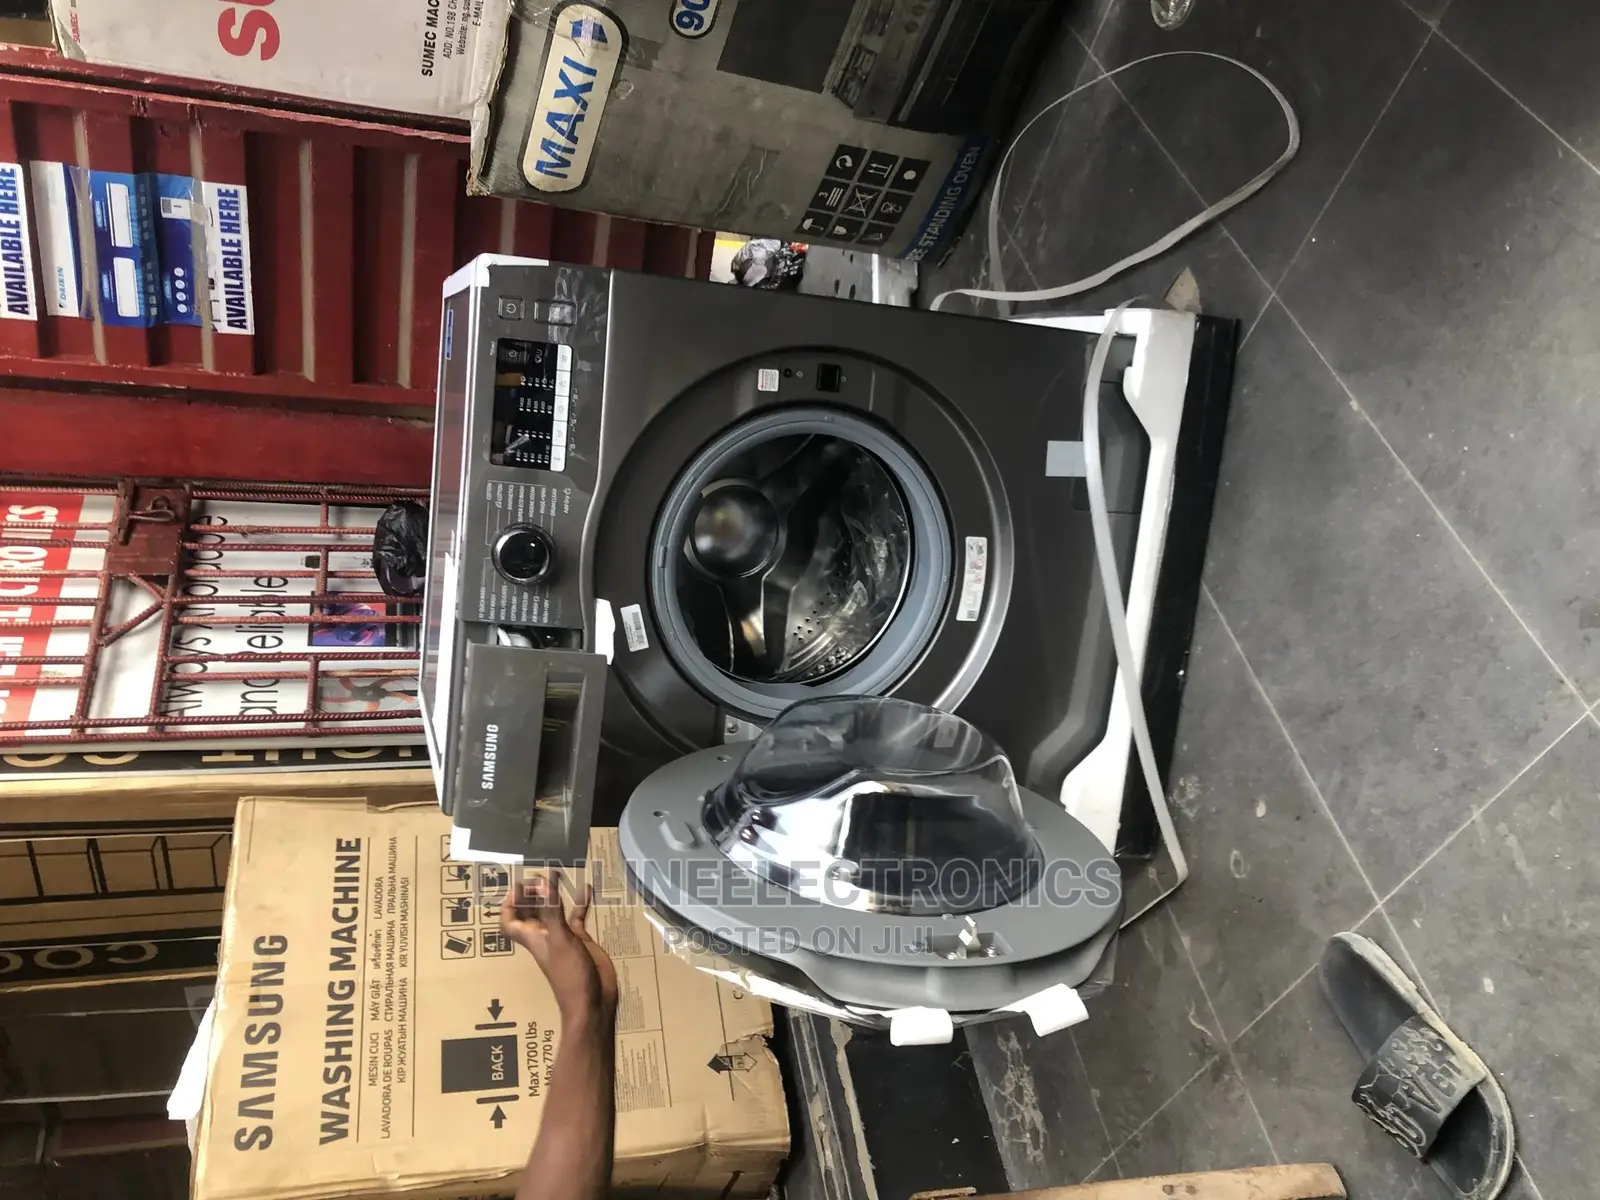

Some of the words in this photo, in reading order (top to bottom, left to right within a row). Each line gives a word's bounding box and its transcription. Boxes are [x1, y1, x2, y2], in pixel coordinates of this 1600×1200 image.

[217, 0, 280, 61] S
[445, 11, 456, 39] NO.198
[456, 23, 468, 55] Website:
[421, 31, 437, 77] SUMEC
[443, 40, 453, 59] ADD:
[534, 55, 598, 180] MAXI
[0, 167, 19, 215] HERE
[217, 187, 241, 235] HERE
[918, 186, 962, 247] STANDING
[953, 145, 982, 184] OVEN
[1, 219, 30, 315] AVAILABLE
[56, 266, 67, 300] DAIKIN
[221, 237, 247, 330] AVAILABLE
[235, 575, 289, 655] eliable
[481, 723, 499, 790] SAMSUNG
[388, 836, 398, 874] МАШИНА
[328, 837, 362, 972] MACHINE
[373, 876, 384, 920] LAVADORA
[386, 875, 397, 914] ПРАЛЬНА
[399, 876, 410, 922] MASHINASI
[386, 919, 396, 961] МАШИНА
[399, 922, 409, 953] YUVISH
[398, 953, 409, 968] KIR
[368, 1001, 381, 1021] MÁY
[384, 962, 395, 1022] СТИРАЛЬНАЯ
[397, 976, 408, 1023] МАШИНА
[234, 934, 289, 1152] SAMSUNG
[369, 1032, 379, 1054] CUCI
[383, 1028, 393, 1068] ROUPAS
[525, 1021, 537, 1040] lbs
[542, 1029, 555, 1043] kg
[318, 980, 356, 1146] WASHING
[368, 1055, 379, 1087] MESIN
[490, 1044, 504, 1081] BACK
[526, 1041, 539, 1070] 1700
[543, 1044, 553, 1063] 770
[382, 1069, 392, 1083] DE
[528, 1071, 540, 1097] Max
[380, 1084, 392, 1139] LAVADORA
